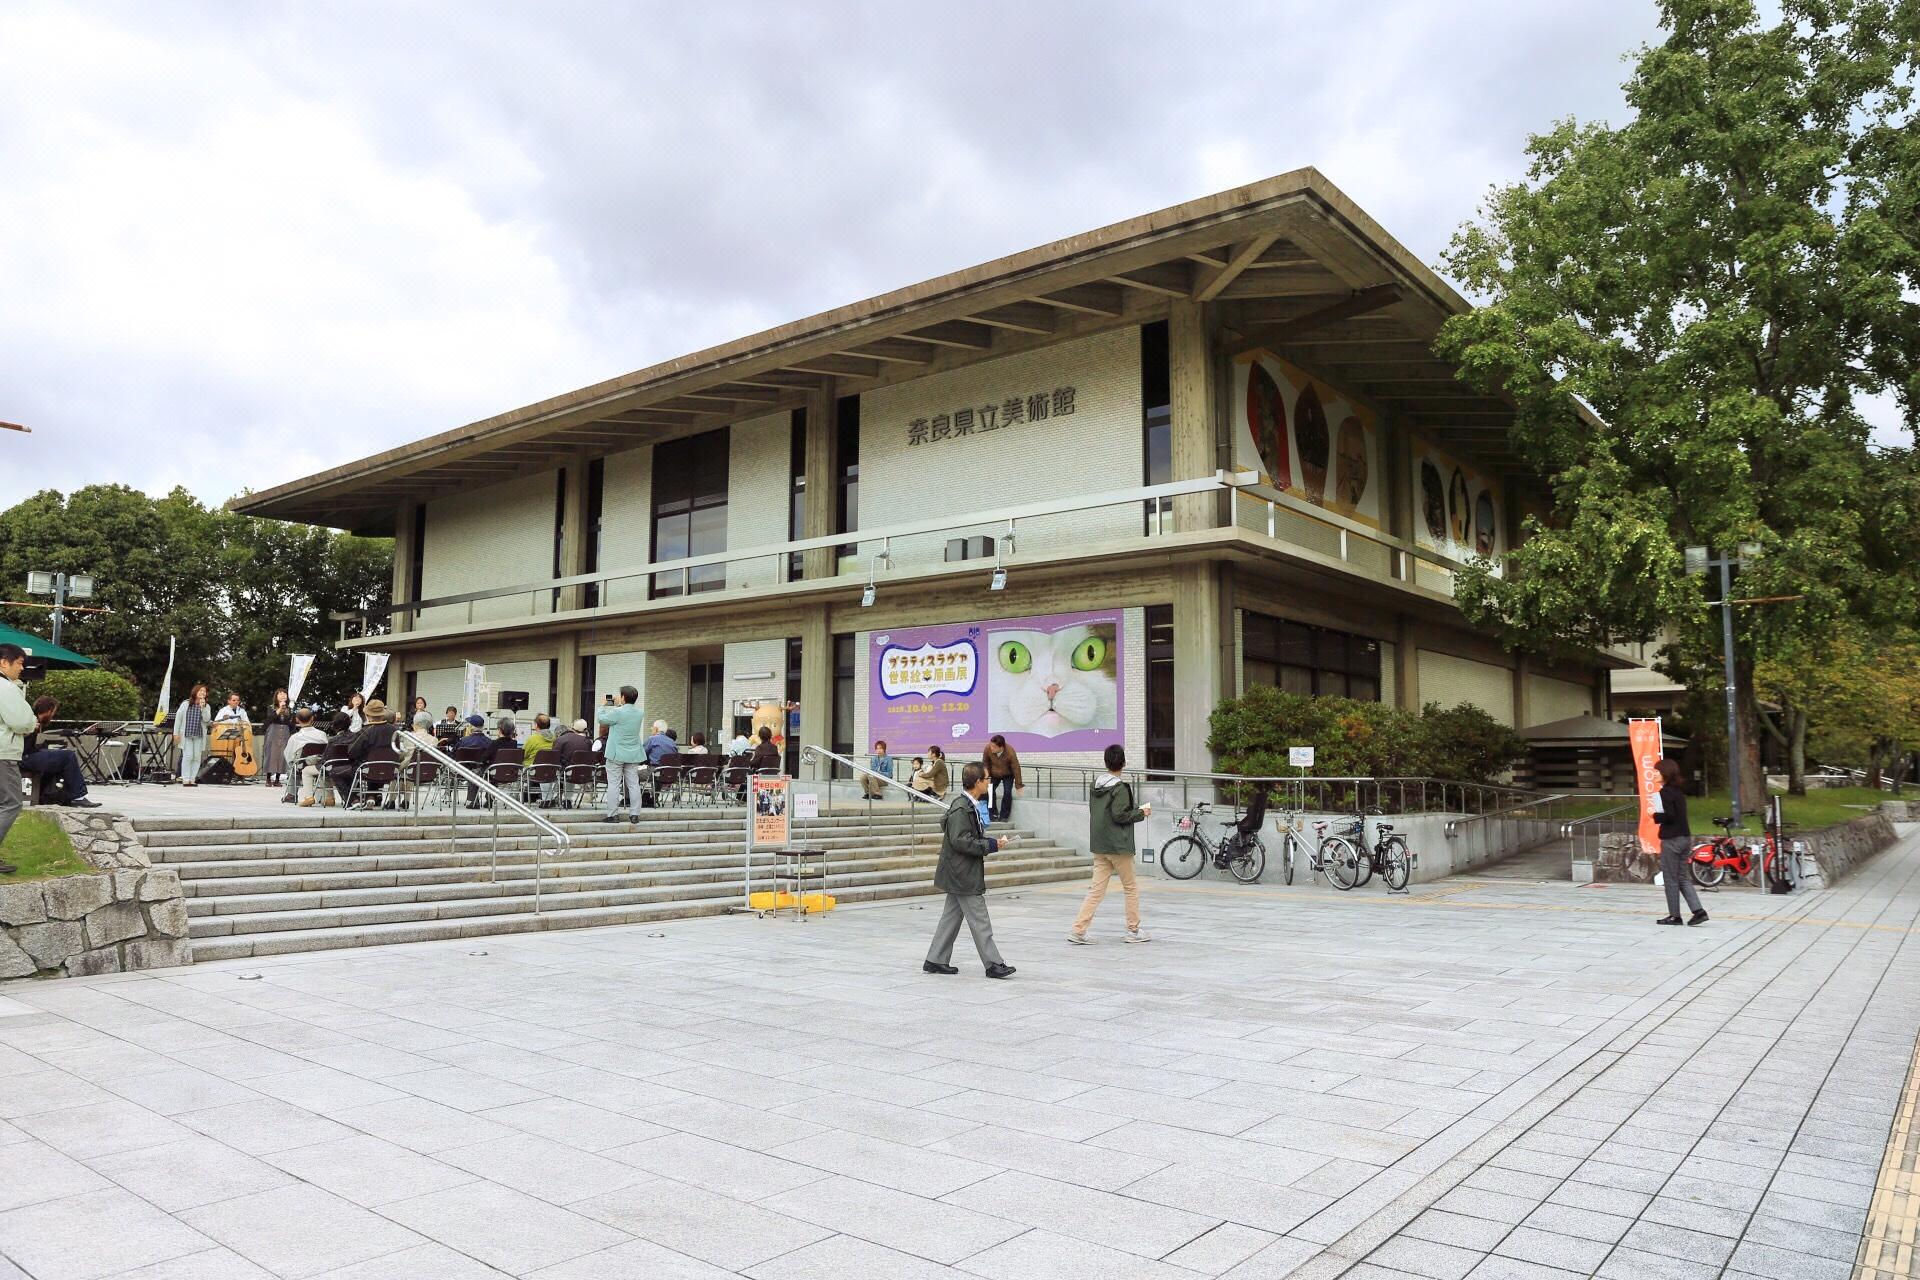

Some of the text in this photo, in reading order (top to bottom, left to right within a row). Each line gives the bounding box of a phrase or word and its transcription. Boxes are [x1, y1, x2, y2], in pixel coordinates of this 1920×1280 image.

[908, 386, 1076, 446] 奈良県立美術館
[888, 667, 968, 685] 世界絵本原画展
